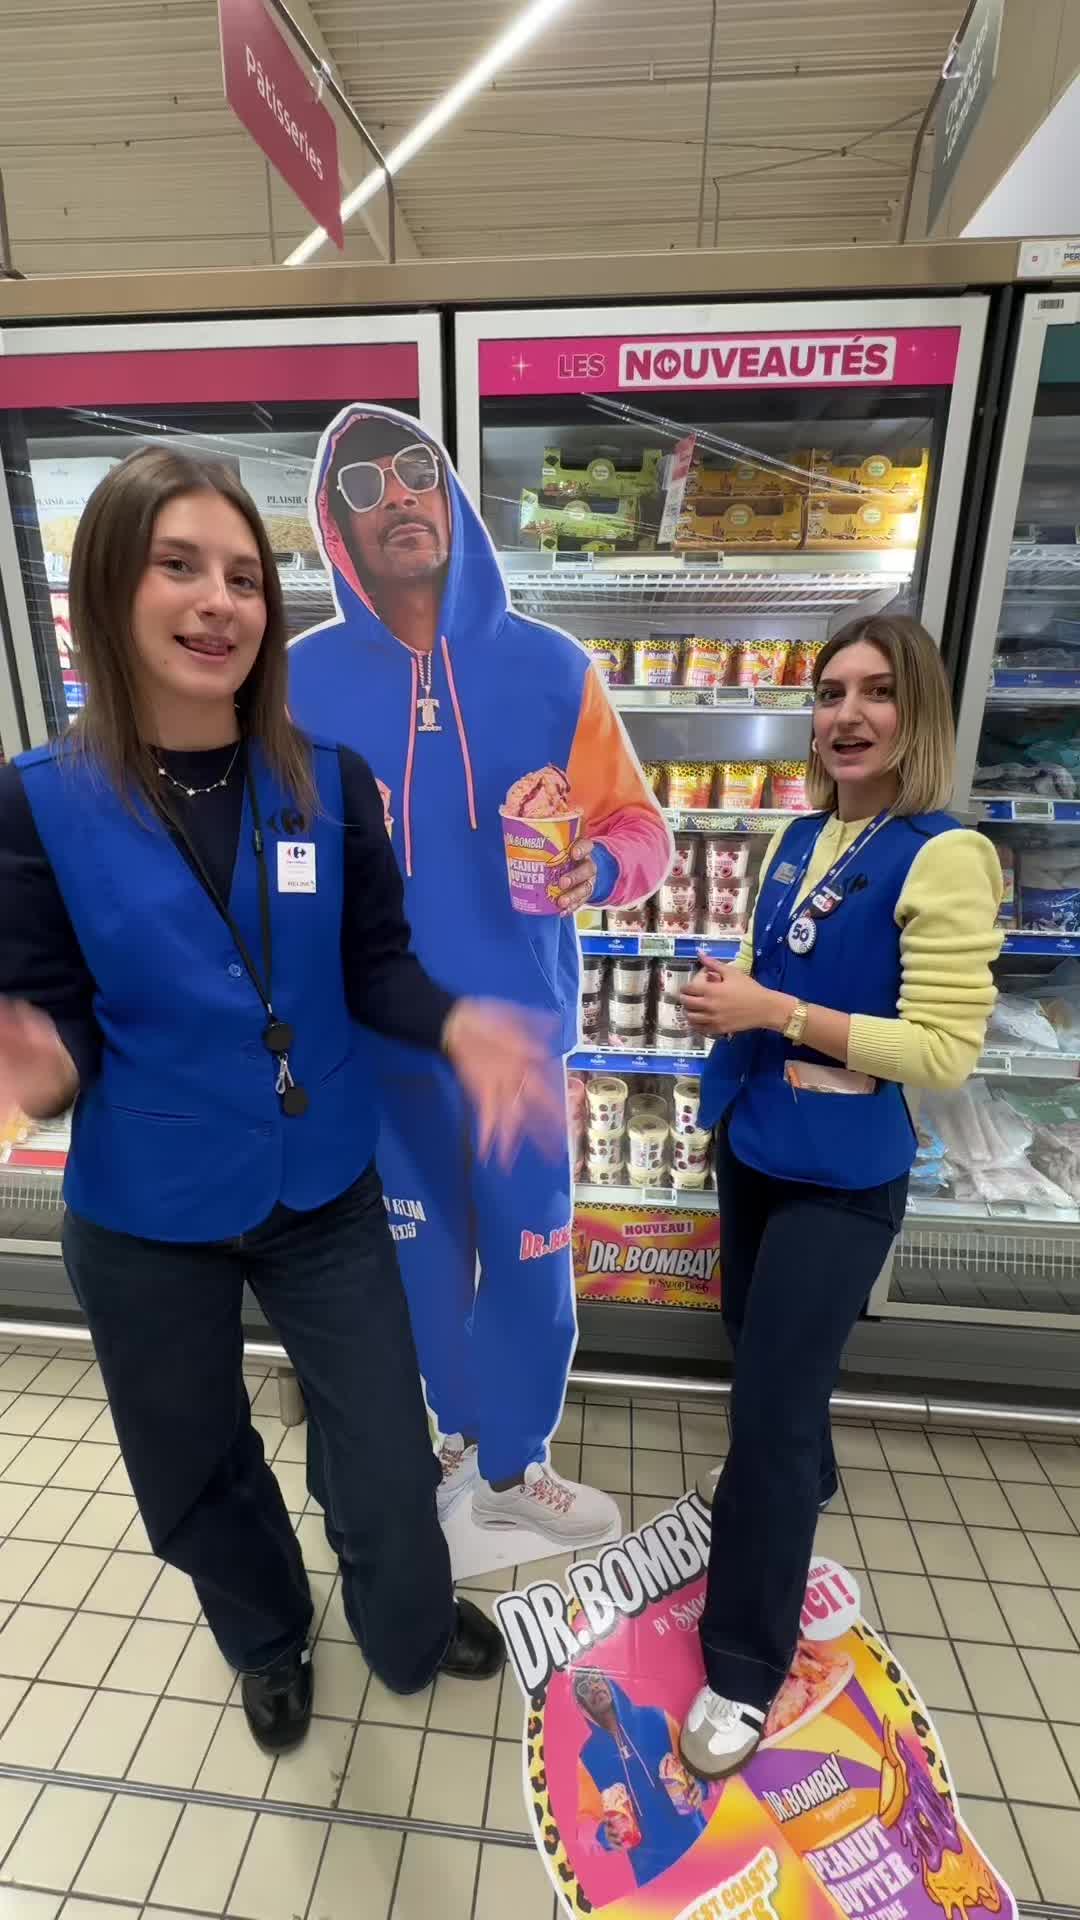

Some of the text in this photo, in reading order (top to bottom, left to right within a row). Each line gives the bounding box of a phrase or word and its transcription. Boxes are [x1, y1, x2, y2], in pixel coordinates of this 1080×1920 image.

[245, 43, 323, 181] Pâtisseries
[558, 336, 888, 381] LES NOUVEAUTÉS
[652, 1616, 671, 1636] BY
[802, 1817, 892, 1881] PEANUT
[826, 1851, 915, 1914] BUTTER
